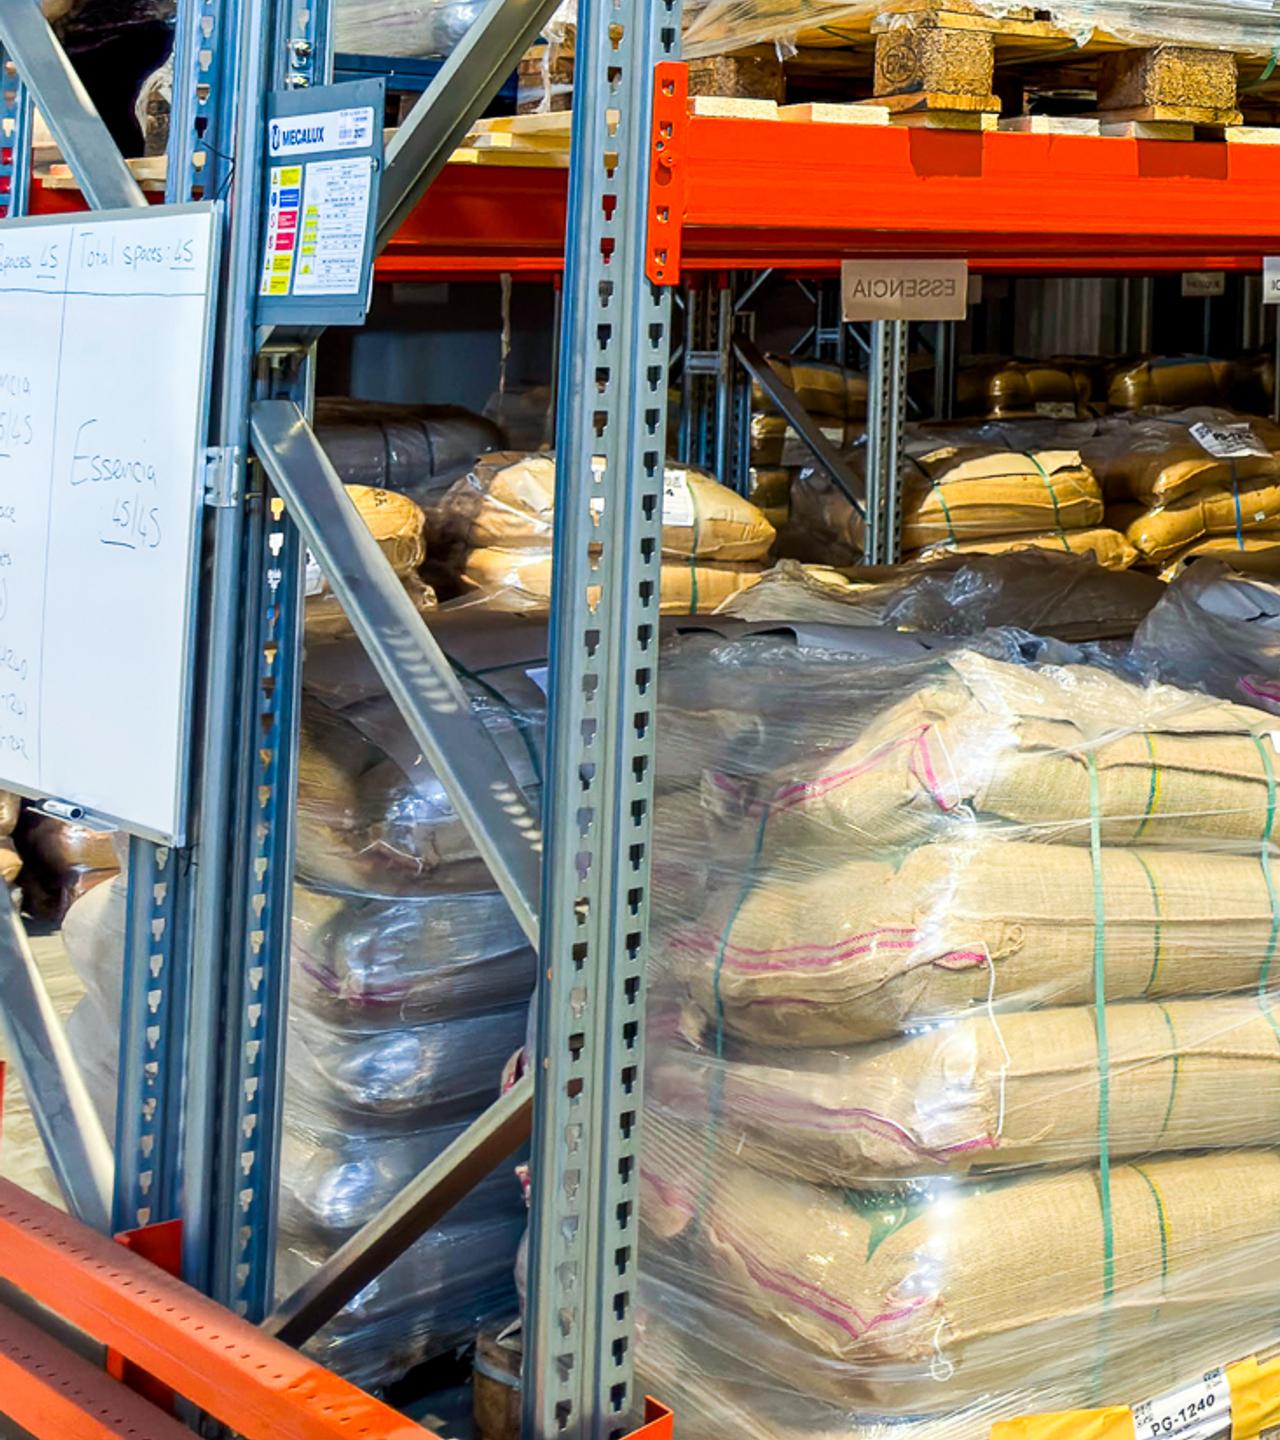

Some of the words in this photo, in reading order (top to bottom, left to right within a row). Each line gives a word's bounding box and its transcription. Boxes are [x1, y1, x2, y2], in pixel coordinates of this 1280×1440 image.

[283, 126, 325, 147] MECALUX
[80, 232, 115, 269] Total
[71, 419, 157, 488] Essencia
[1151, 1394, 1215, 1436] PG-1240
